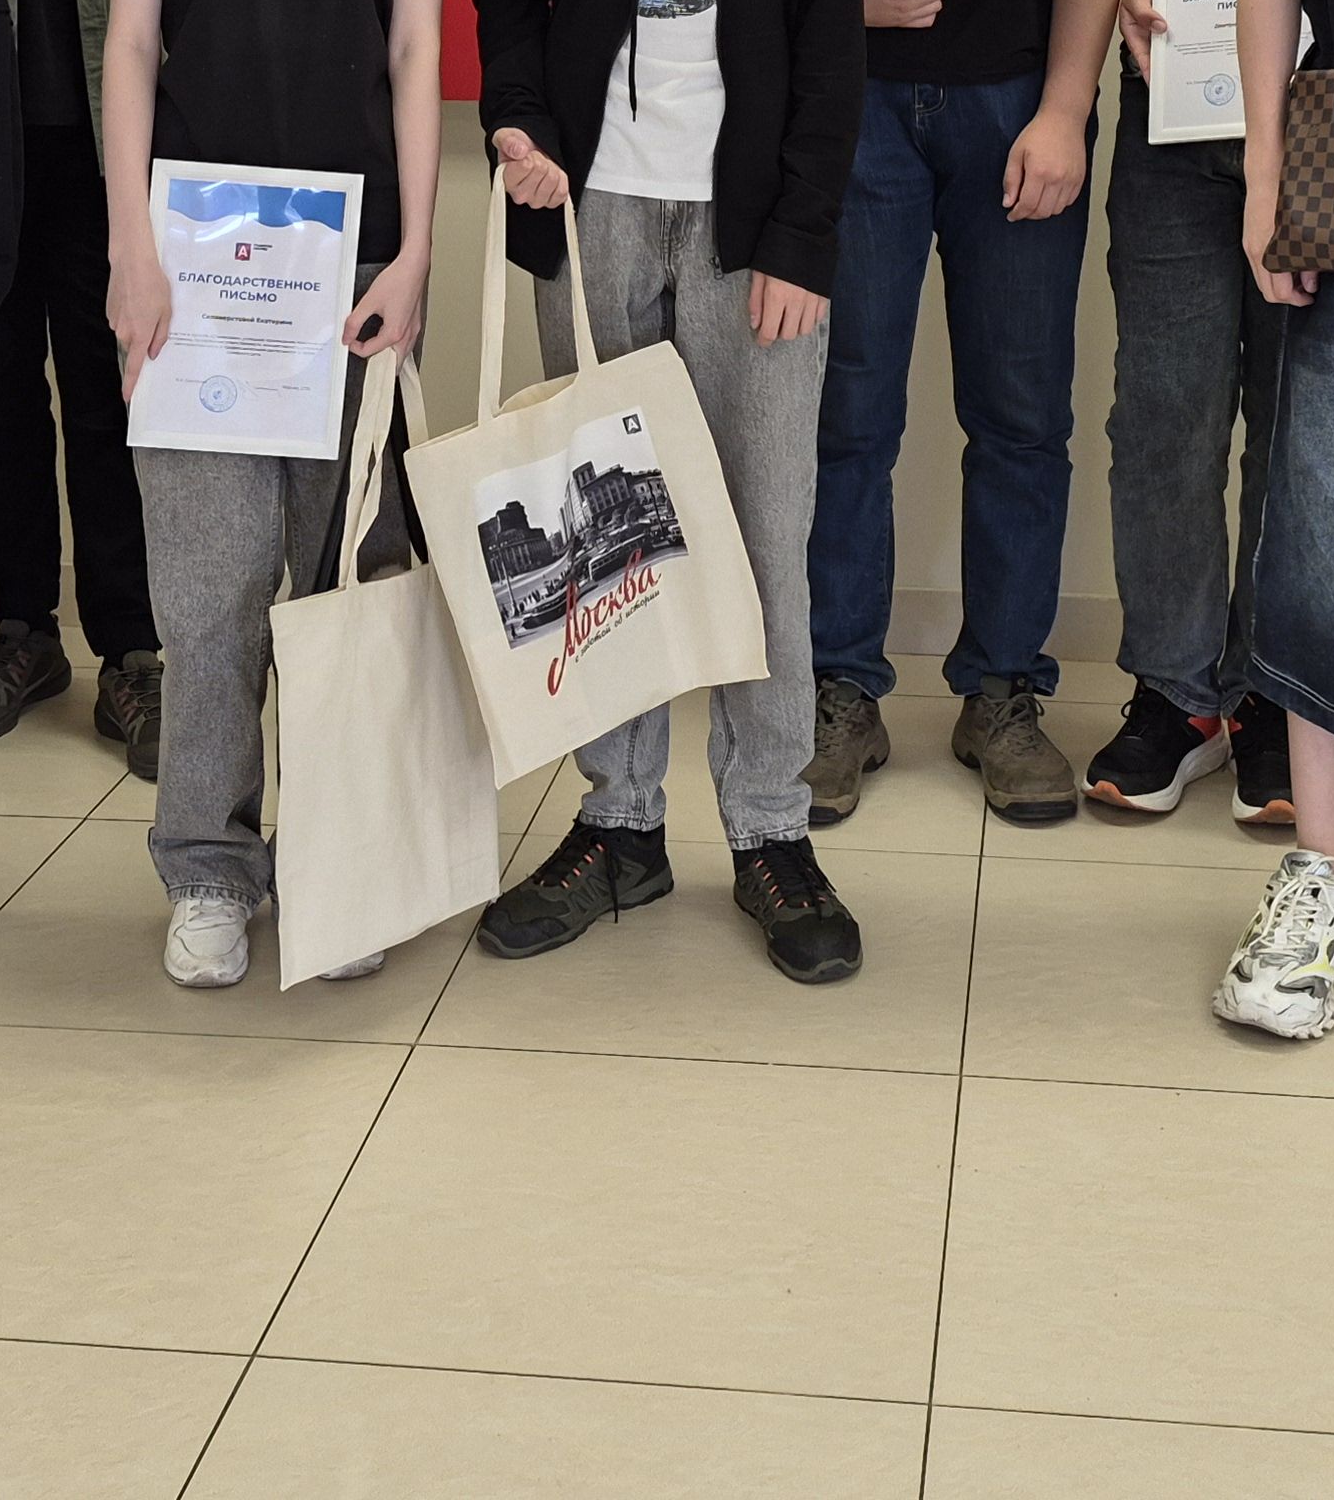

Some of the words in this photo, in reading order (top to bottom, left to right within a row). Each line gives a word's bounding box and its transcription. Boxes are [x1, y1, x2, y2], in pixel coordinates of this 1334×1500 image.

[178, 272, 321, 292] БЛАГОДАРСТВЕННОЕ
[219, 290, 277, 303] ПИСЬМО
[625, 590, 660, 618] истории
[547, 548, 662, 696] Москва
